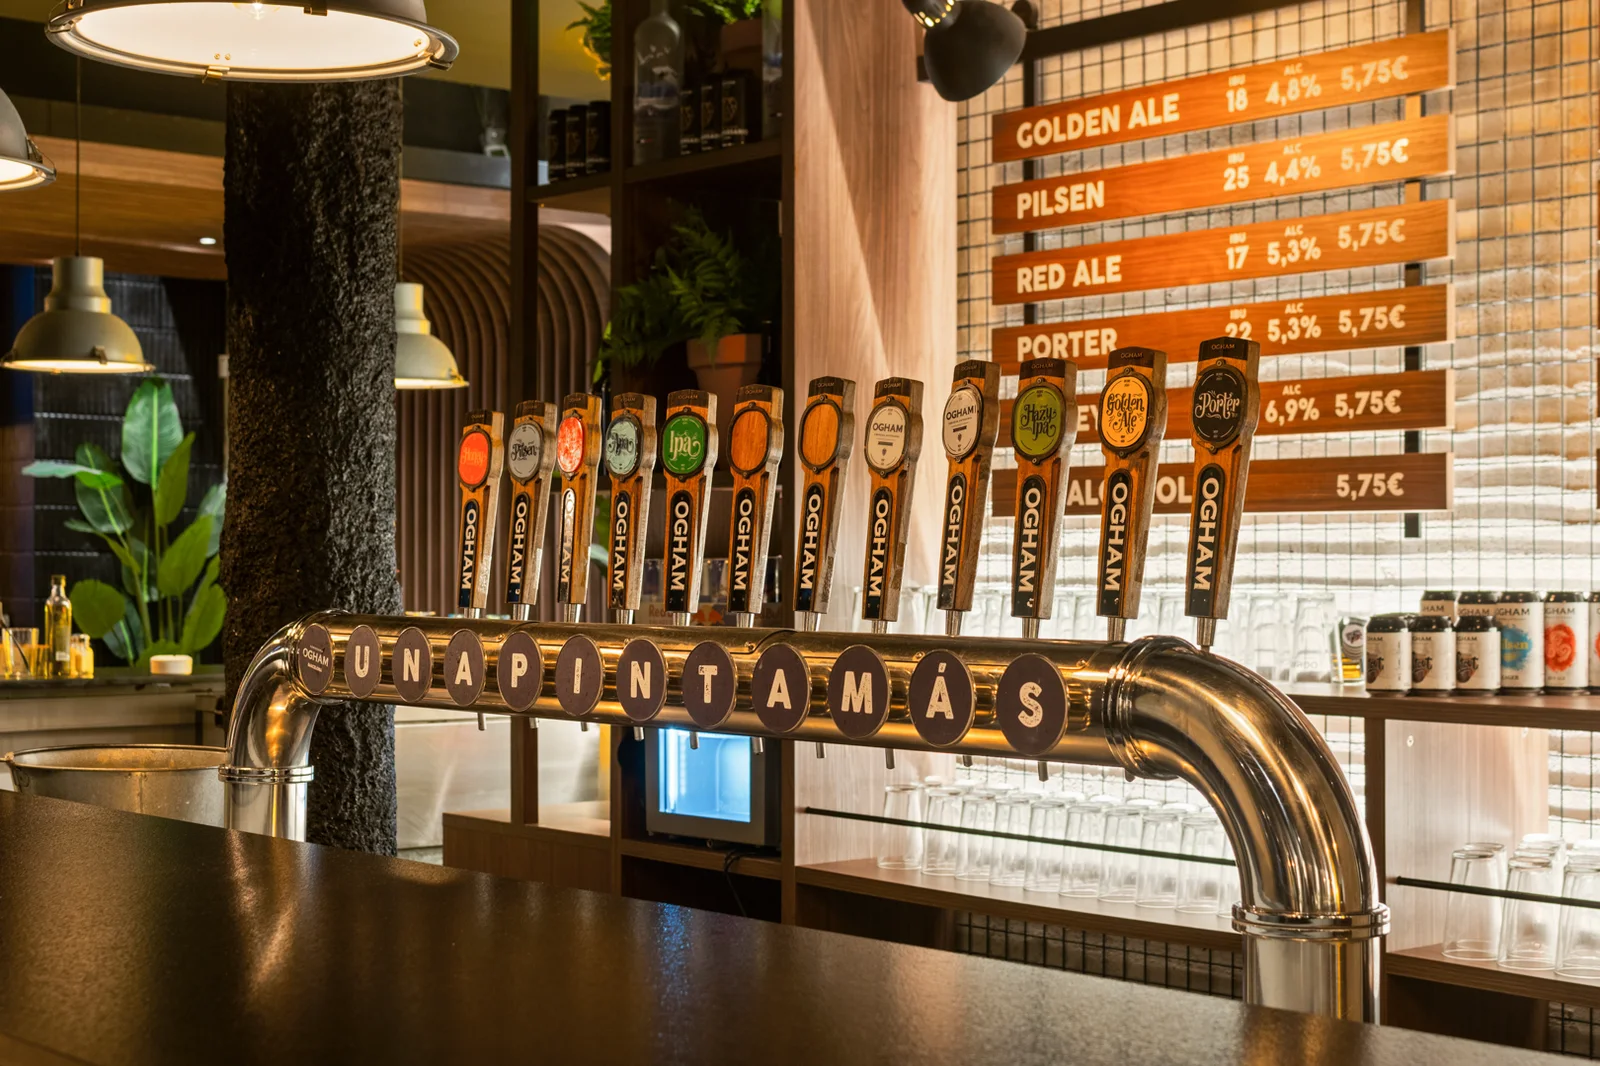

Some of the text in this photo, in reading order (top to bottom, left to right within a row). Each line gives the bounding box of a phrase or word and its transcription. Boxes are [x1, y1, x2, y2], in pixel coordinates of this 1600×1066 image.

[1266, 74, 1321, 105] 4,8%
[1340, 56, 1409, 92] 5,75€
[1226, 86, 1248, 112] 18
[1016, 94, 1180, 149] GOLDEN ALE
[1340, 138, 1409, 172] 5,75€
[1223, 166, 1250, 191] 25
[1264, 156, 1321, 186] 4,4%
[1016, 180, 1105, 219] PILSEN
[1338, 218, 1406, 251] 5,75€
[1226, 245, 1249, 271] 17
[1267, 237, 1321, 268] 5,3%
[1016, 255, 1122, 293] RED ALE
[1285, 303, 1304, 314] ALC
[1338, 304, 1406, 338] 5,75€
[1017, 327, 1118, 362] PORTER
[1225, 321, 1252, 341] 22
[1267, 315, 1322, 345] 5,3%
[1106, 393, 1145, 416] Golden
[1195, 391, 1240, 420] Porter
[1283, 384, 1301, 396] ALC
[1335, 389, 1402, 420] 5,75€
[872, 423, 903, 433] OGHAM
[946, 405, 974, 420] OGHAM
[1020, 404, 1057, 427] Hazy
[1113, 411, 1136, 434] Ale
[1265, 399, 1320, 426] 6,9%
[669, 430, 701, 461] Ipa
[1067, 476, 1192, 506] ALOL
[1336, 472, 1404, 501] 5,75€
[461, 508, 477, 589] OGHAM
[510, 501, 527, 584] OGHAM
[560, 499, 575, 583] OGHAM
[613, 501, 628, 590] OGHAM
[670, 501, 689, 591] OGHAM
[734, 499, 752, 591] OGHAM
[801, 493, 821, 589] OGHAM
[869, 499, 889, 597] OGHAM
[943, 485, 963, 585] OGHAM
[1018, 487, 1041, 592] OGHAM
[1105, 482, 1128, 592] OGHAM
[1194, 477, 1220, 591] OGHAM
[302, 647, 329, 667] OGHAM
